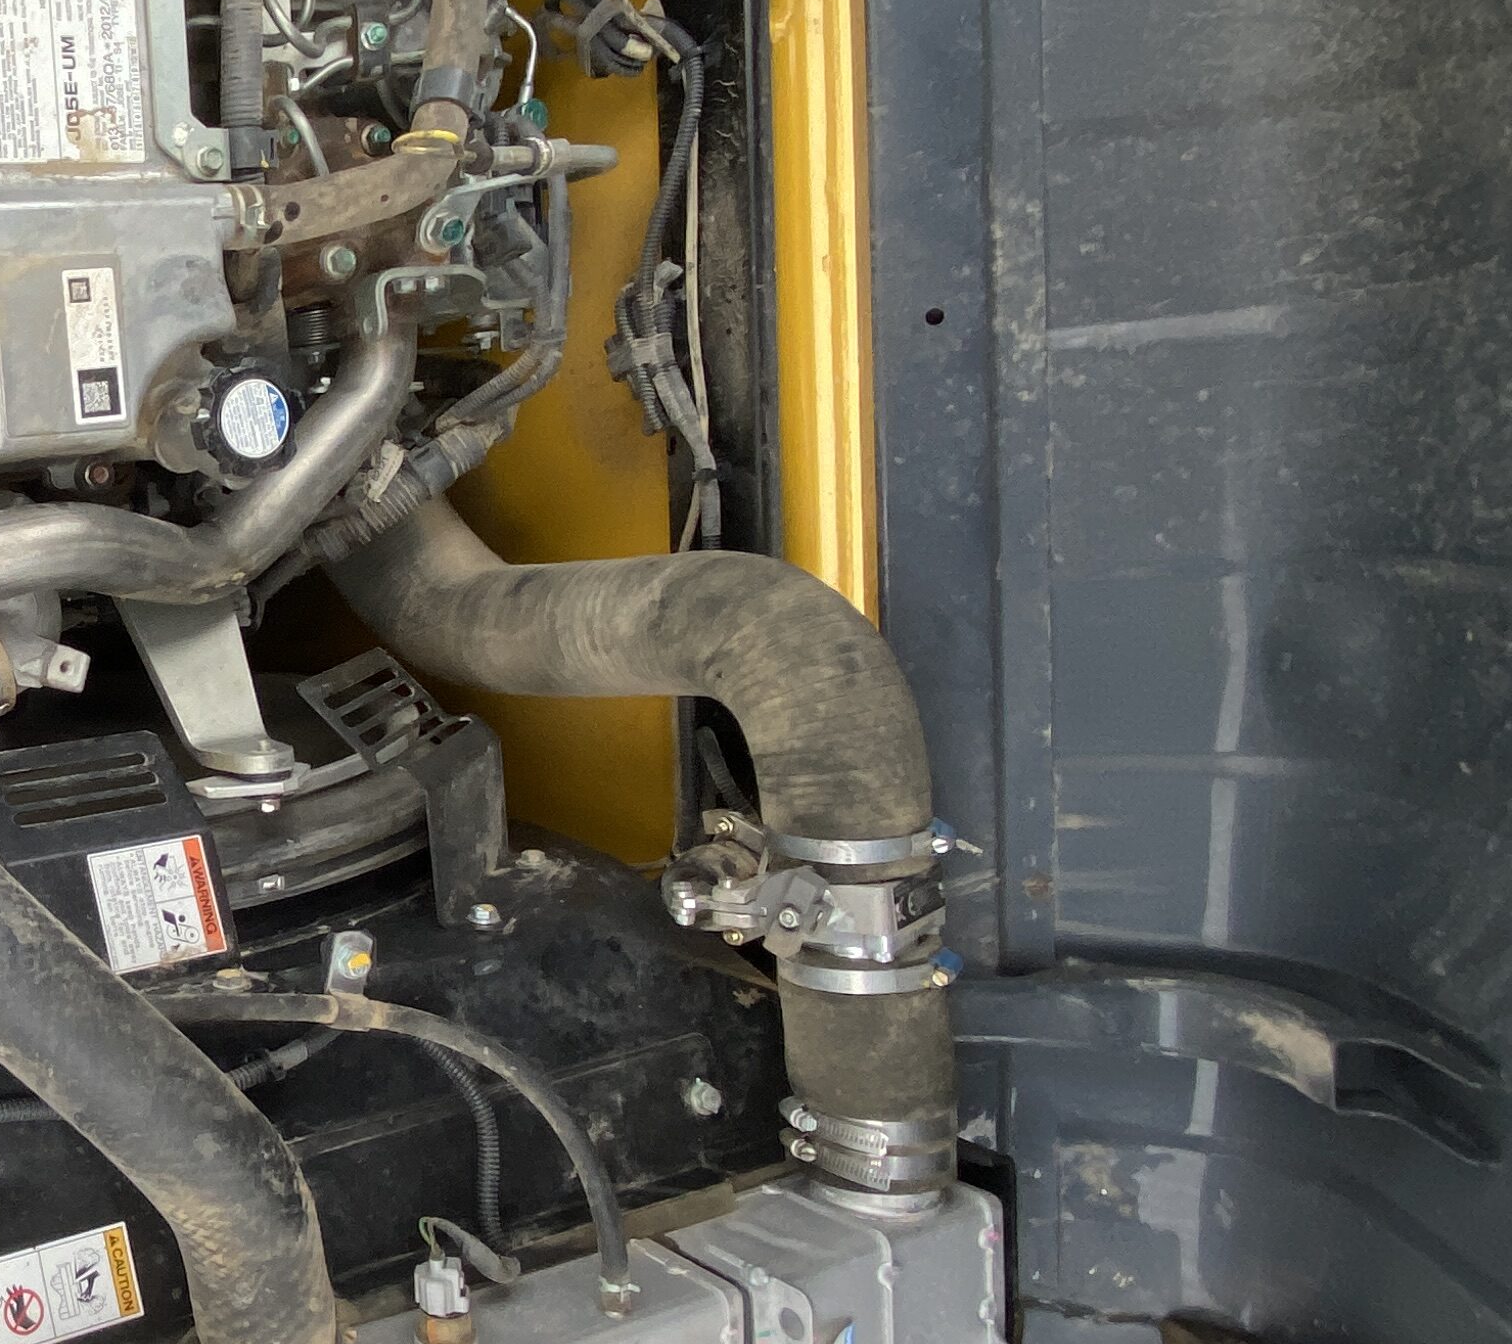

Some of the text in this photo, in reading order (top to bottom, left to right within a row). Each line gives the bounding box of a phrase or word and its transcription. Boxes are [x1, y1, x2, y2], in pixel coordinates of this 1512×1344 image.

[60, 36, 81, 141] J05E-UM
[194, 867, 217, 935] WARNING
[112, 1248, 134, 1311] CAUTION
